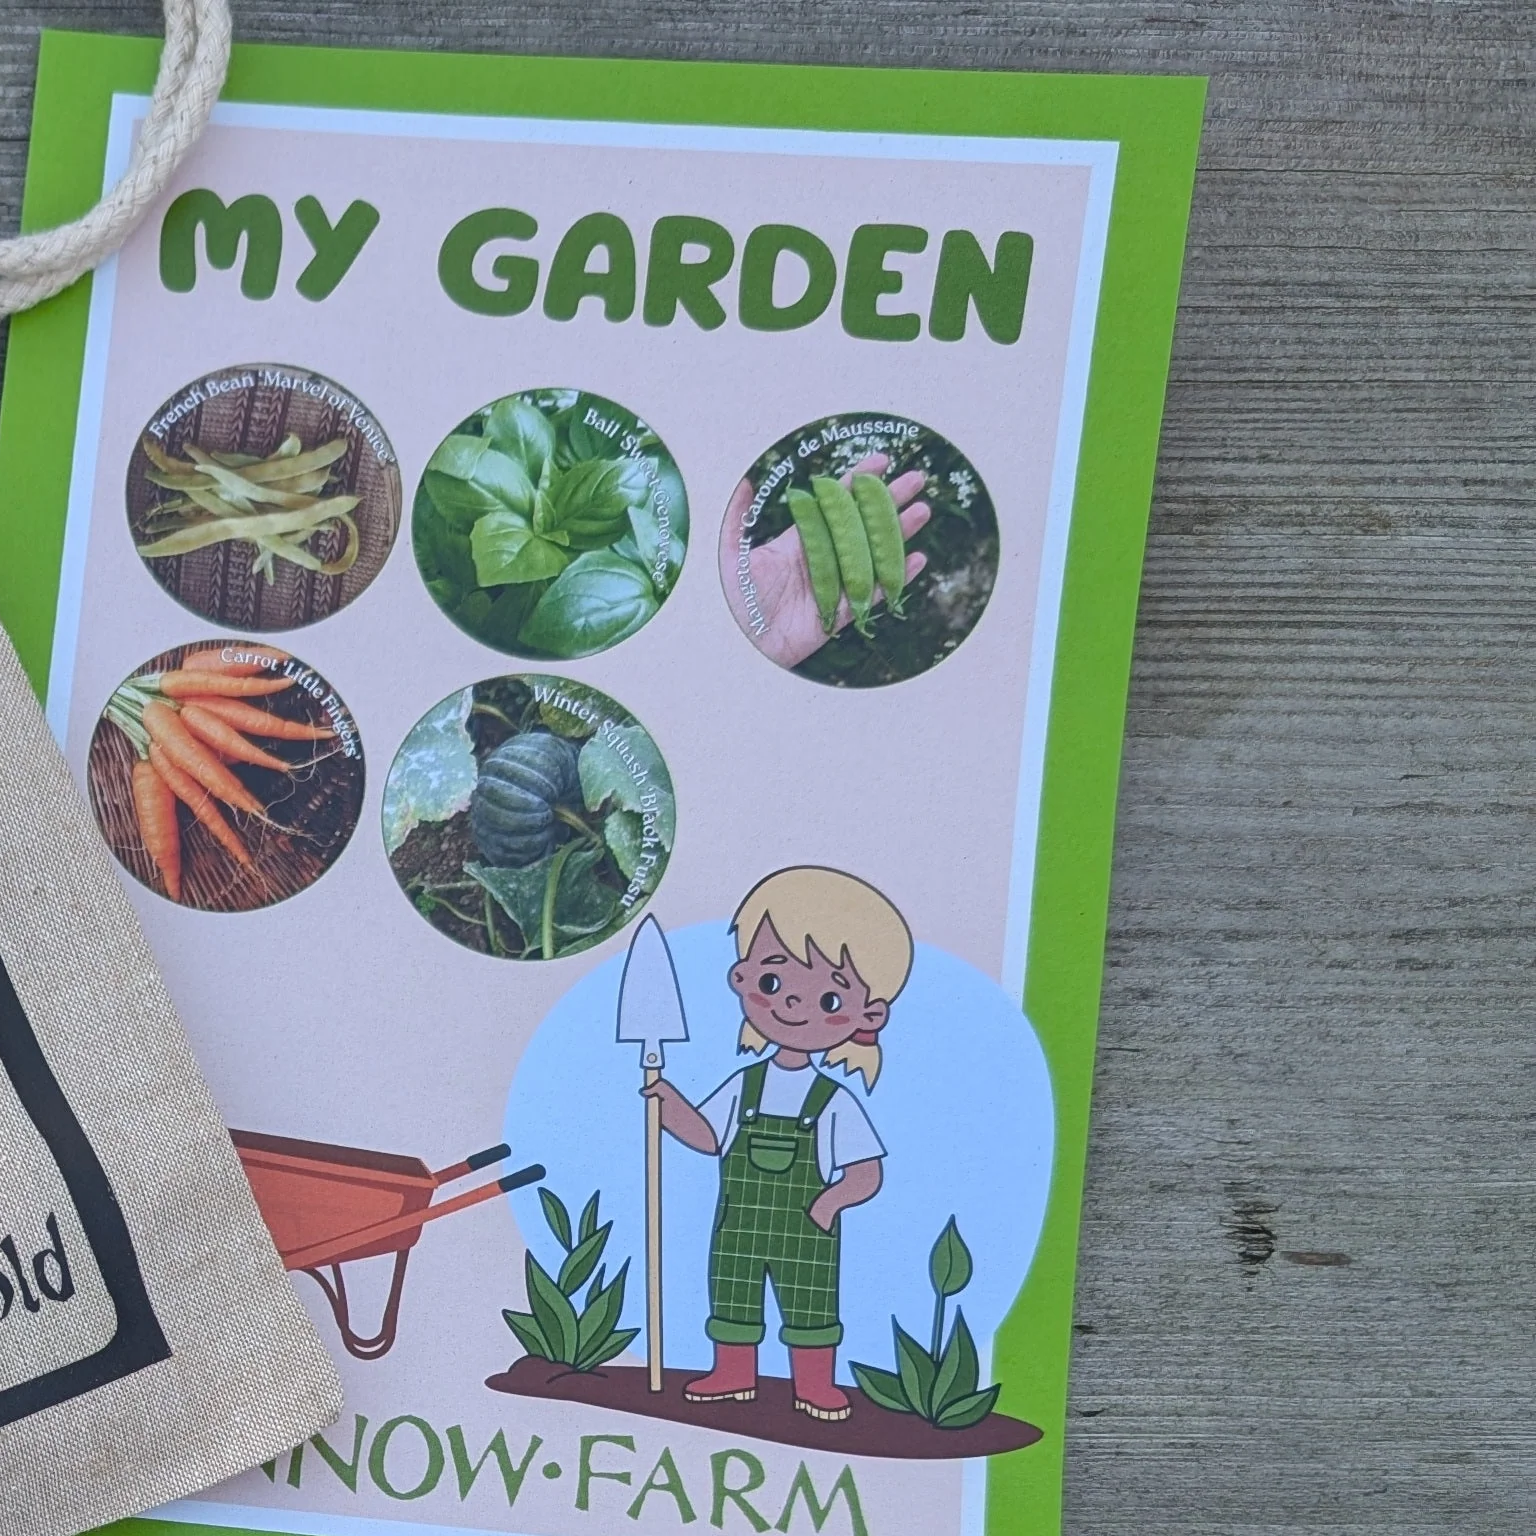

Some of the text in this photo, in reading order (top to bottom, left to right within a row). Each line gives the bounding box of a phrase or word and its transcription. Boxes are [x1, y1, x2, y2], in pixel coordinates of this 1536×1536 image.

[158, 187, 1035, 345] MY GARDEN
[148, 386, 206, 440] French
[204, 373, 255, 399] Bean
[328, 394, 350, 411] of
[583, 407, 621, 438] Bail
[736, 535, 771, 636] Mangetout
[797, 436, 821, 458] de
[820, 420, 920, 444] Maussane
[220, 648, 278, 671] Carrot
[533, 685, 600, 726] Winter
[597, 719, 649, 787] Squash
